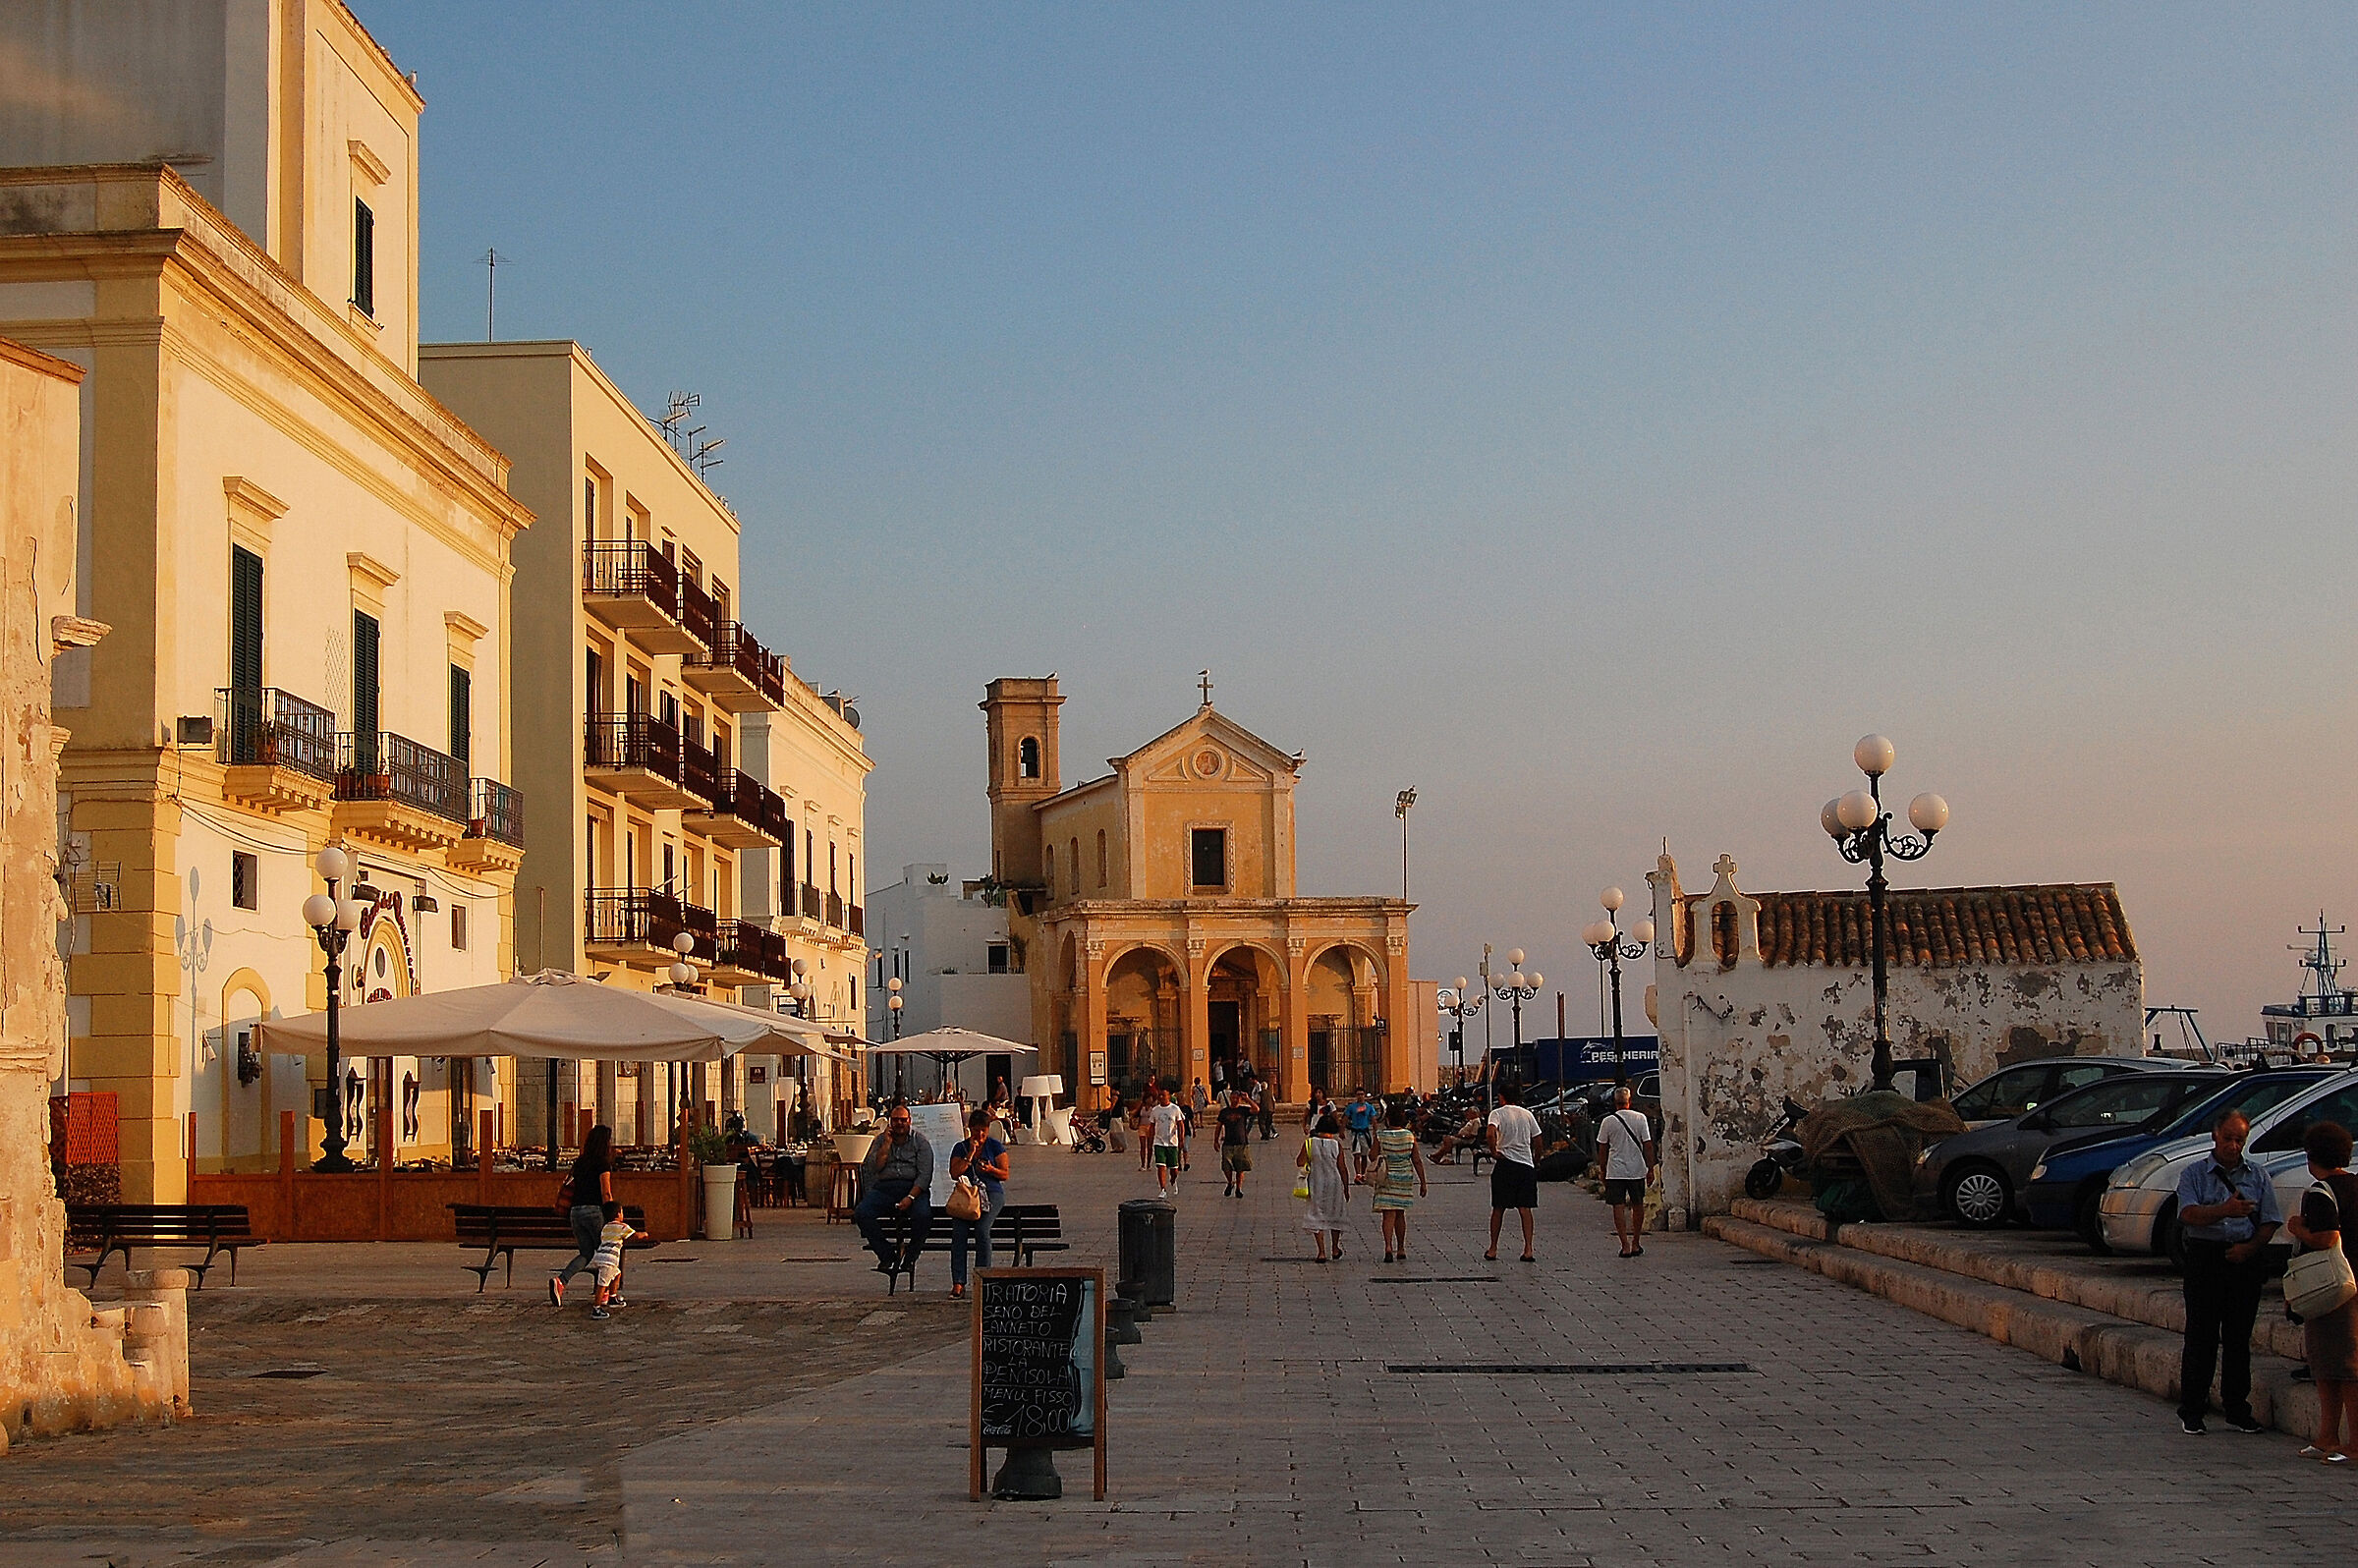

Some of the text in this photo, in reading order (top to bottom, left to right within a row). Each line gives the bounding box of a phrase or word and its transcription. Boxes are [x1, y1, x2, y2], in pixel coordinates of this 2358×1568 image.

[1591, 1050, 1658, 1061] PESHERIA
[983, 1305, 1061, 1319] SENO DEL
[982, 1337, 1069, 1358] RISTORANTE
[1008, 1356, 1028, 1368] LA
[982, 1360, 1068, 1384] PENISOLA
[1035, 1388, 1073, 1406] FISSO
